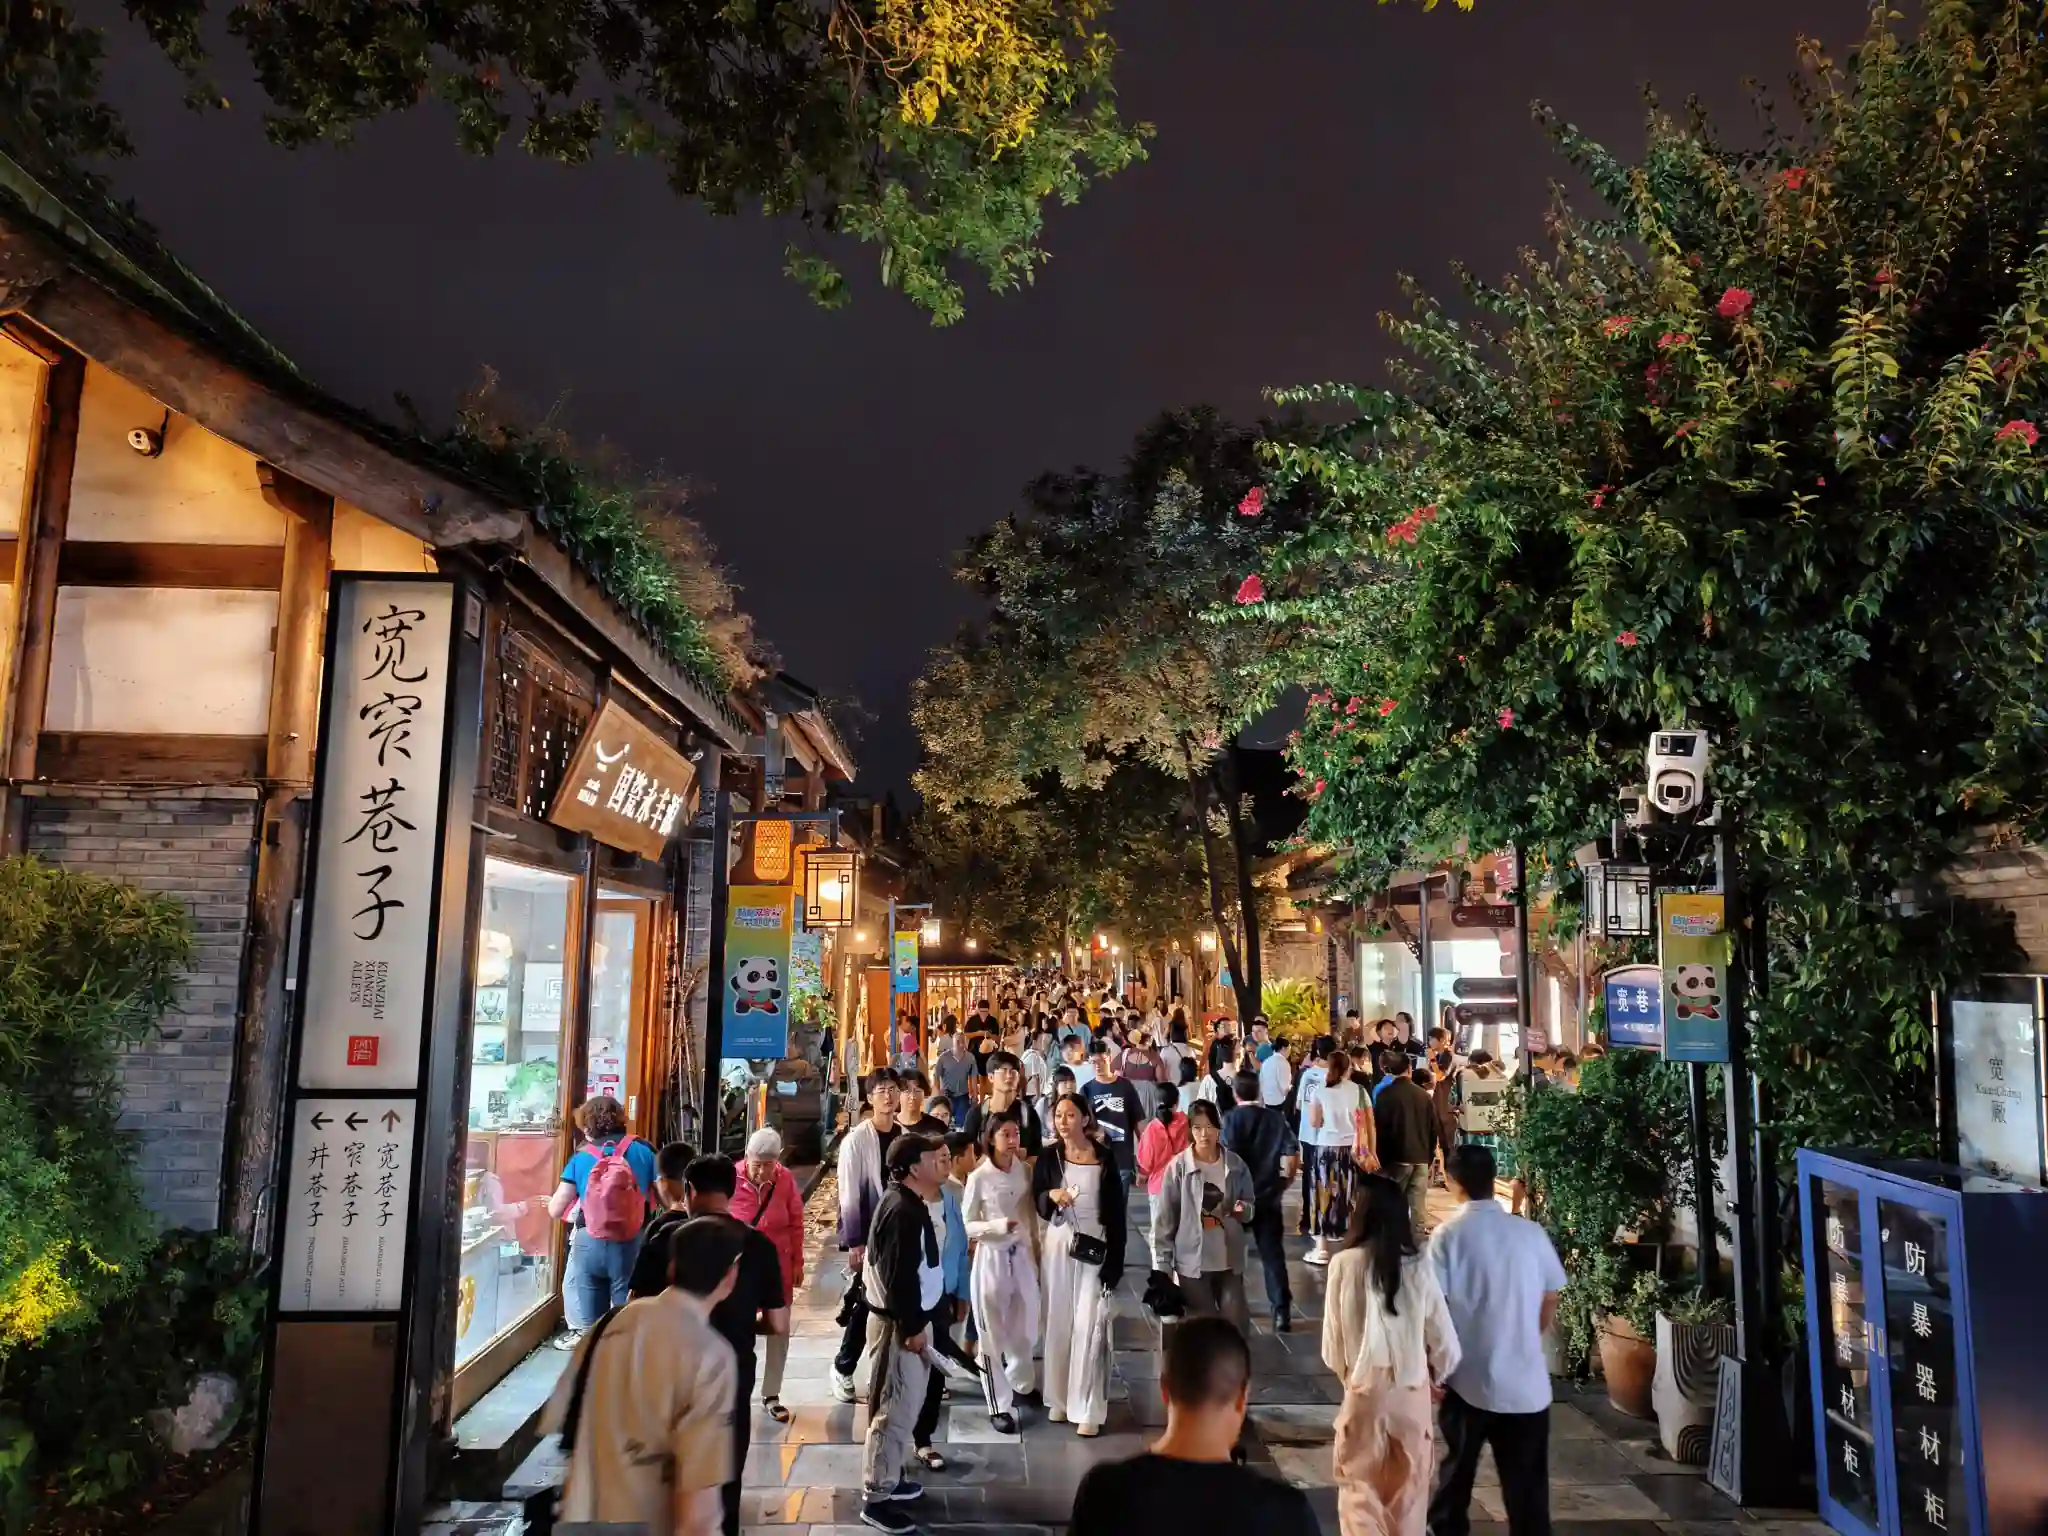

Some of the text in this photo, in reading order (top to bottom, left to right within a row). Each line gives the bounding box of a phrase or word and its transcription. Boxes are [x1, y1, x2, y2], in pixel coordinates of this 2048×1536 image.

[342, 603, 428, 941] 宽窄巷子
[350, 961, 362, 1004] ALLEYS
[362, 960, 375, 1008] XIANGZI
[373, 961, 389, 1020] KUANZHAI
[1616, 987, 1661, 1014] 宽巷
[304, 1142, 330, 1227] 井巷子
[340, 1142, 366, 1227] 窄巷子
[374, 1142, 400, 1227] 宽巷子
[1827, 1220, 1861, 1479] 防暴器材柜
[1904, 1240, 1948, 1532] 防暴器材柜
